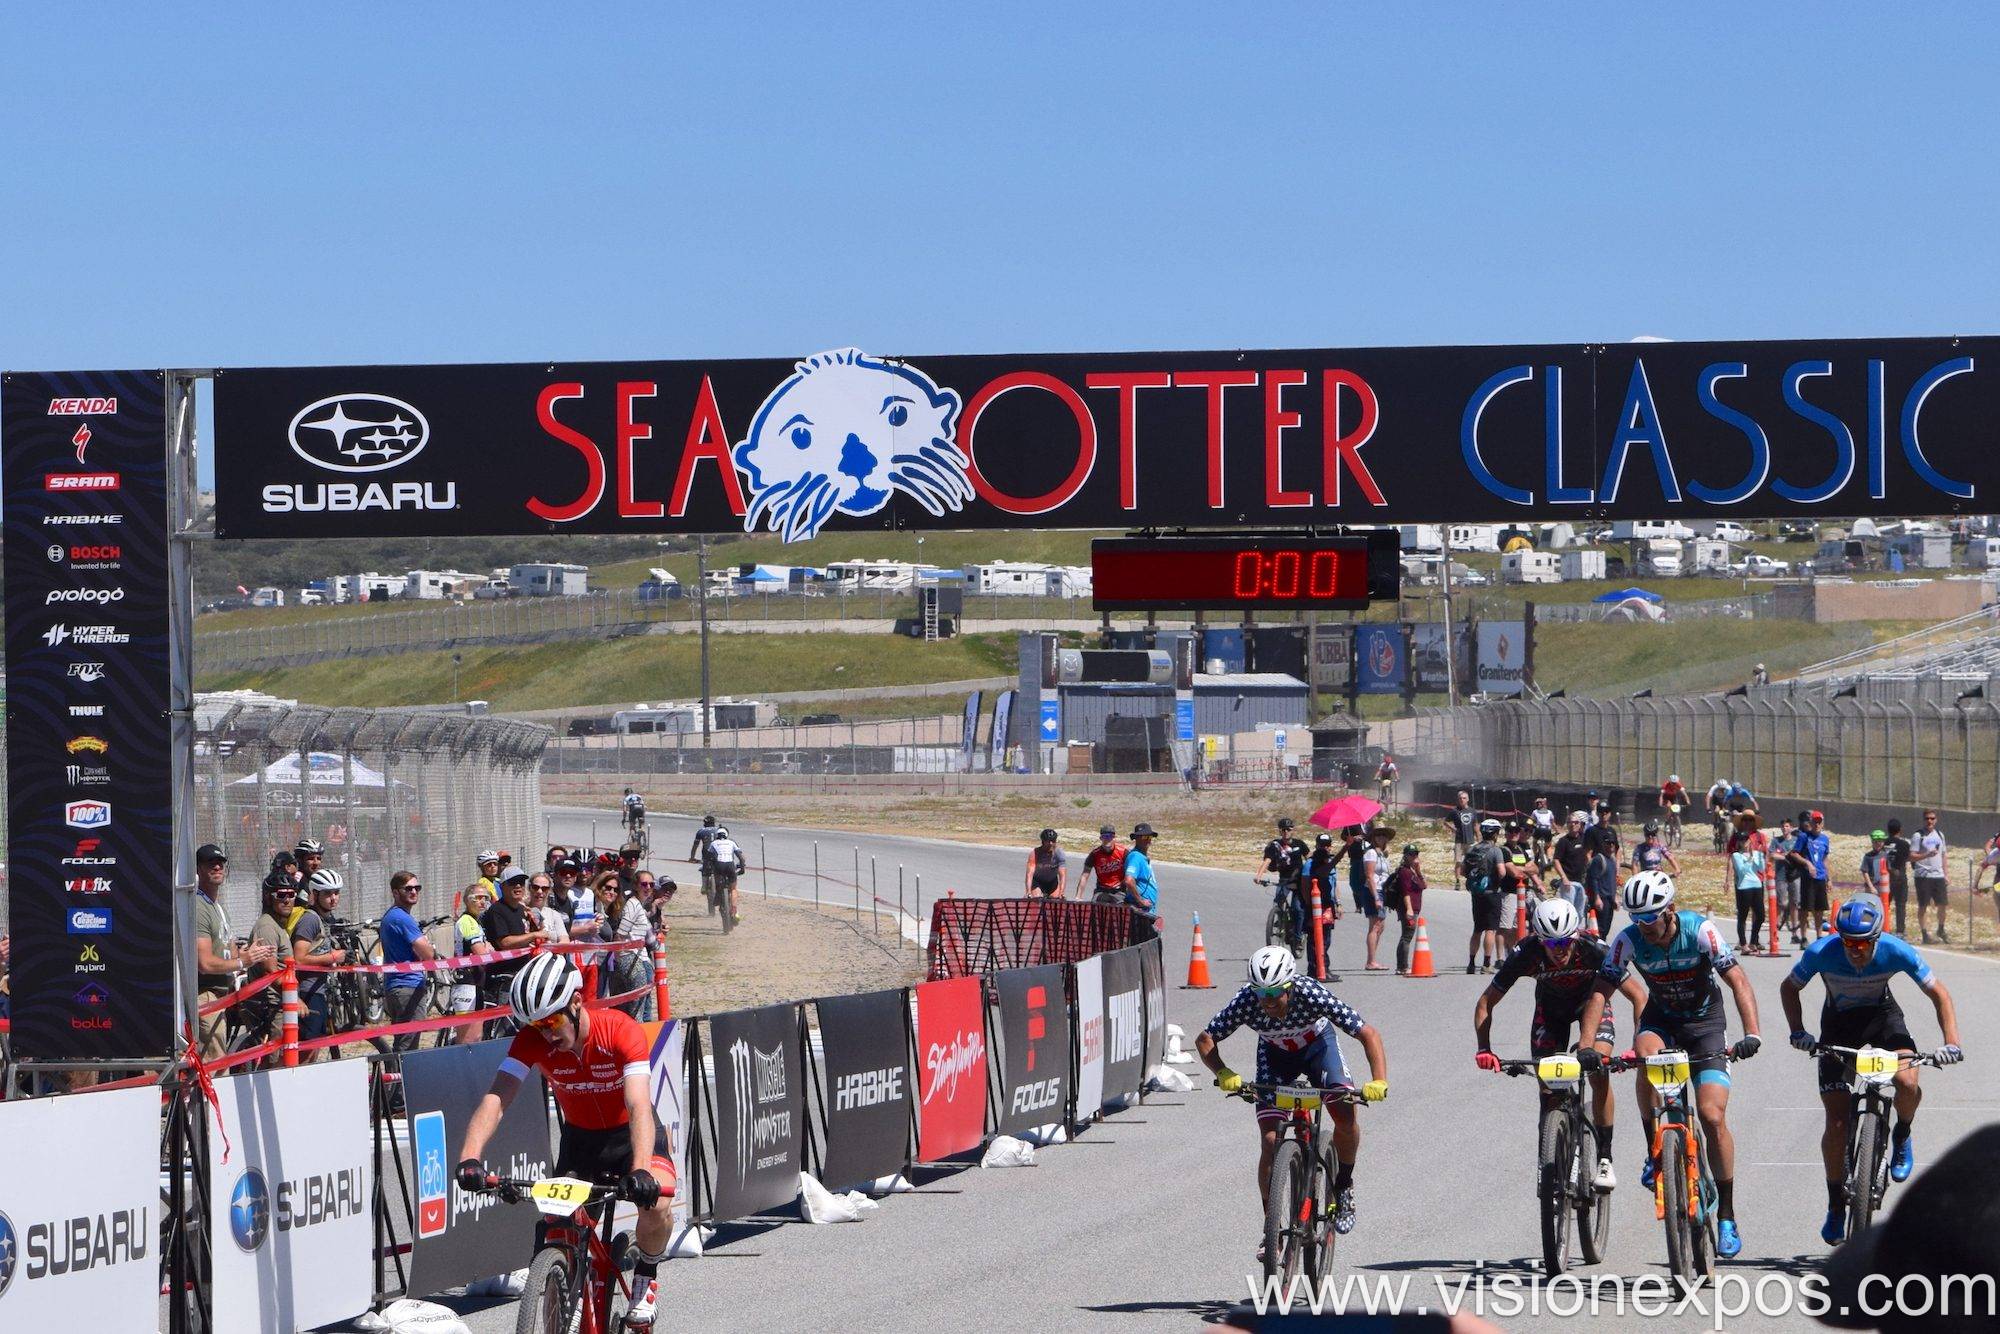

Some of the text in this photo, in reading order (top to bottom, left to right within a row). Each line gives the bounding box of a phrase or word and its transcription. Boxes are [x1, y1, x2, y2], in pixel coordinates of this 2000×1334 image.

[47, 397, 117, 415] KENDA
[525, 356, 1974, 523] SEA OTTER CLASSIC
[49, 476, 116, 488] SRAM
[261, 481, 461, 512] SUBARU
[43, 515, 123, 525] HAIBIKE
[70, 546, 121, 559] BOSCH
[100, 562, 109, 570] for
[1234, 551, 1339, 598] 0:00
[72, 626, 115, 635] HYPER
[72, 634, 130, 643] THREADS
[67, 663, 105, 682] FOX
[68, 705, 105, 717] THULE
[72, 806, 105, 821] 100%
[61, 857, 117, 865] FOCUS
[64, 877, 113, 892] velofix
[1555, 1062, 1563, 1077] 6
[1871, 1057, 1884, 1072] 15
[836, 1066, 904, 1111] HAIBIKE
[1011, 1077, 1061, 1116] FOCUS
[753, 1108, 792, 1149] MONSTER
[276, 1166, 364, 1232] SUBARU
[547, 1183, 573, 1200] 53
[27, 1206, 148, 1280] SUBARU
